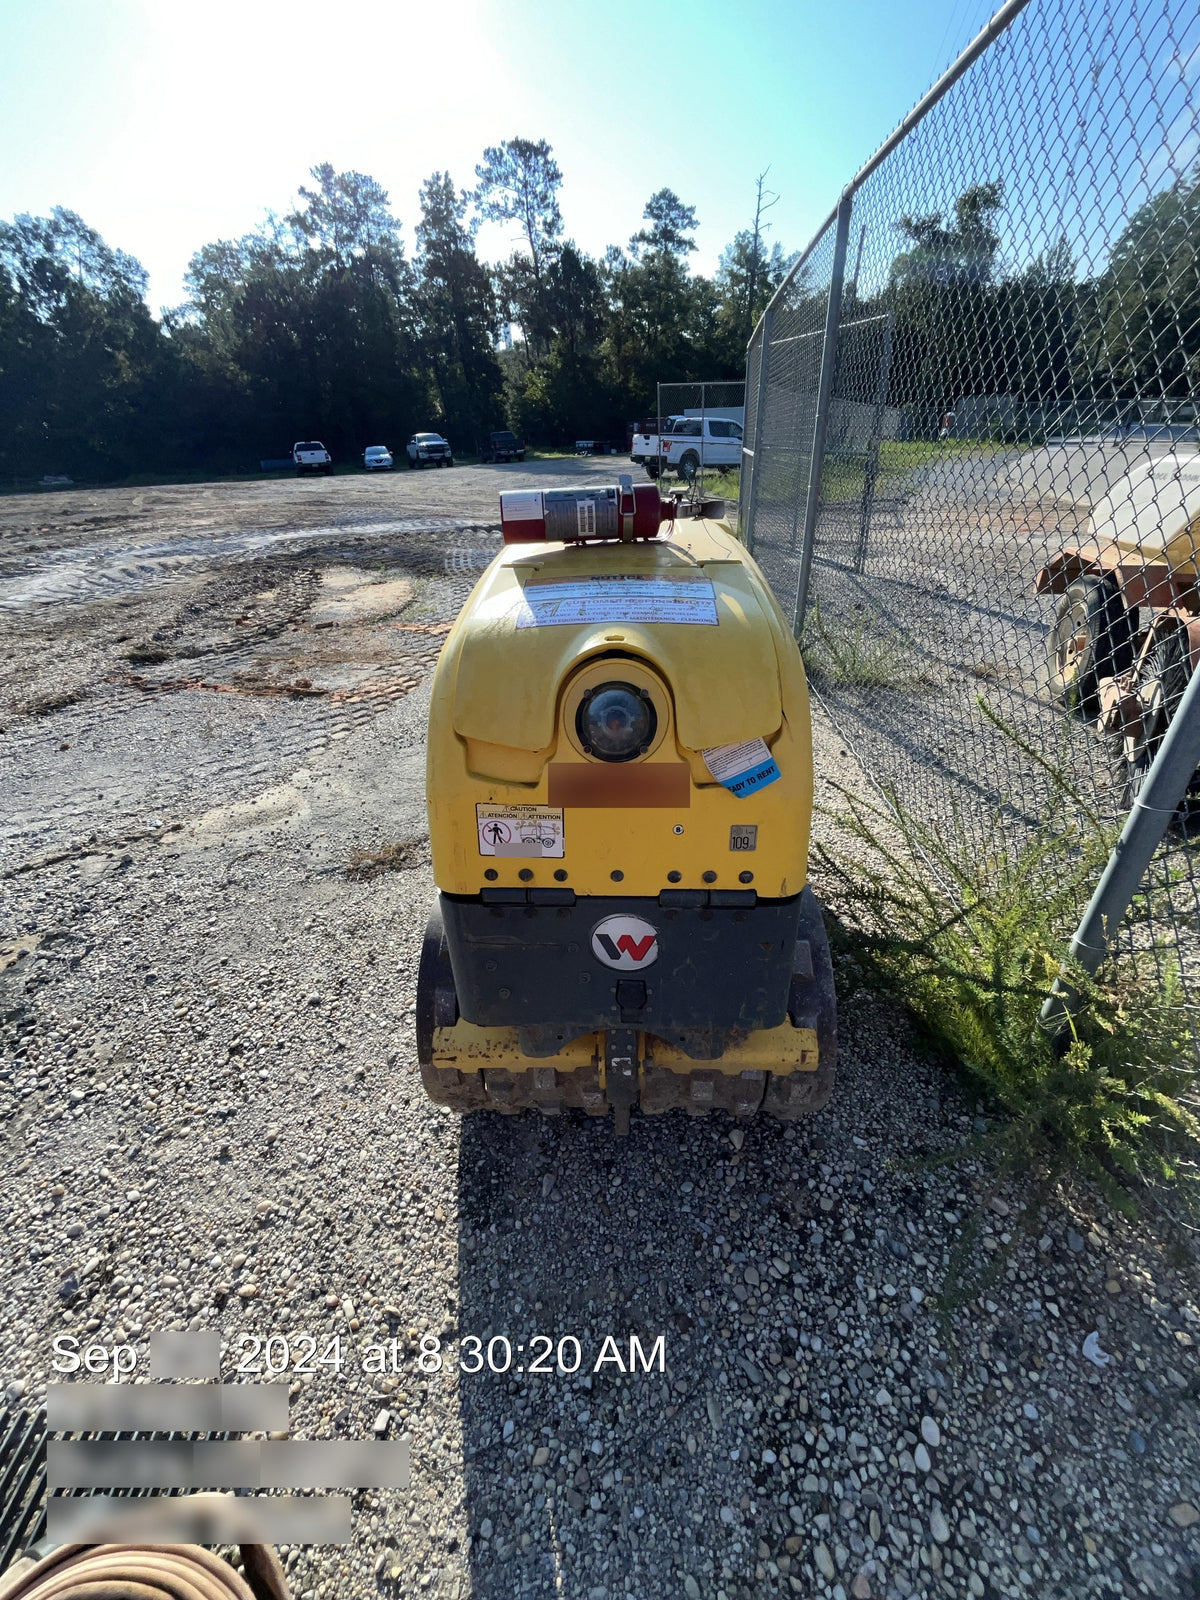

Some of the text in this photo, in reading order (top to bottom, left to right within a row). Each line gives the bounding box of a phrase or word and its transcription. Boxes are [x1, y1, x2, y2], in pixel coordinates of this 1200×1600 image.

[728, 765, 776, 793] EADY TO RENT
[731, 836, 750, 849] 109
